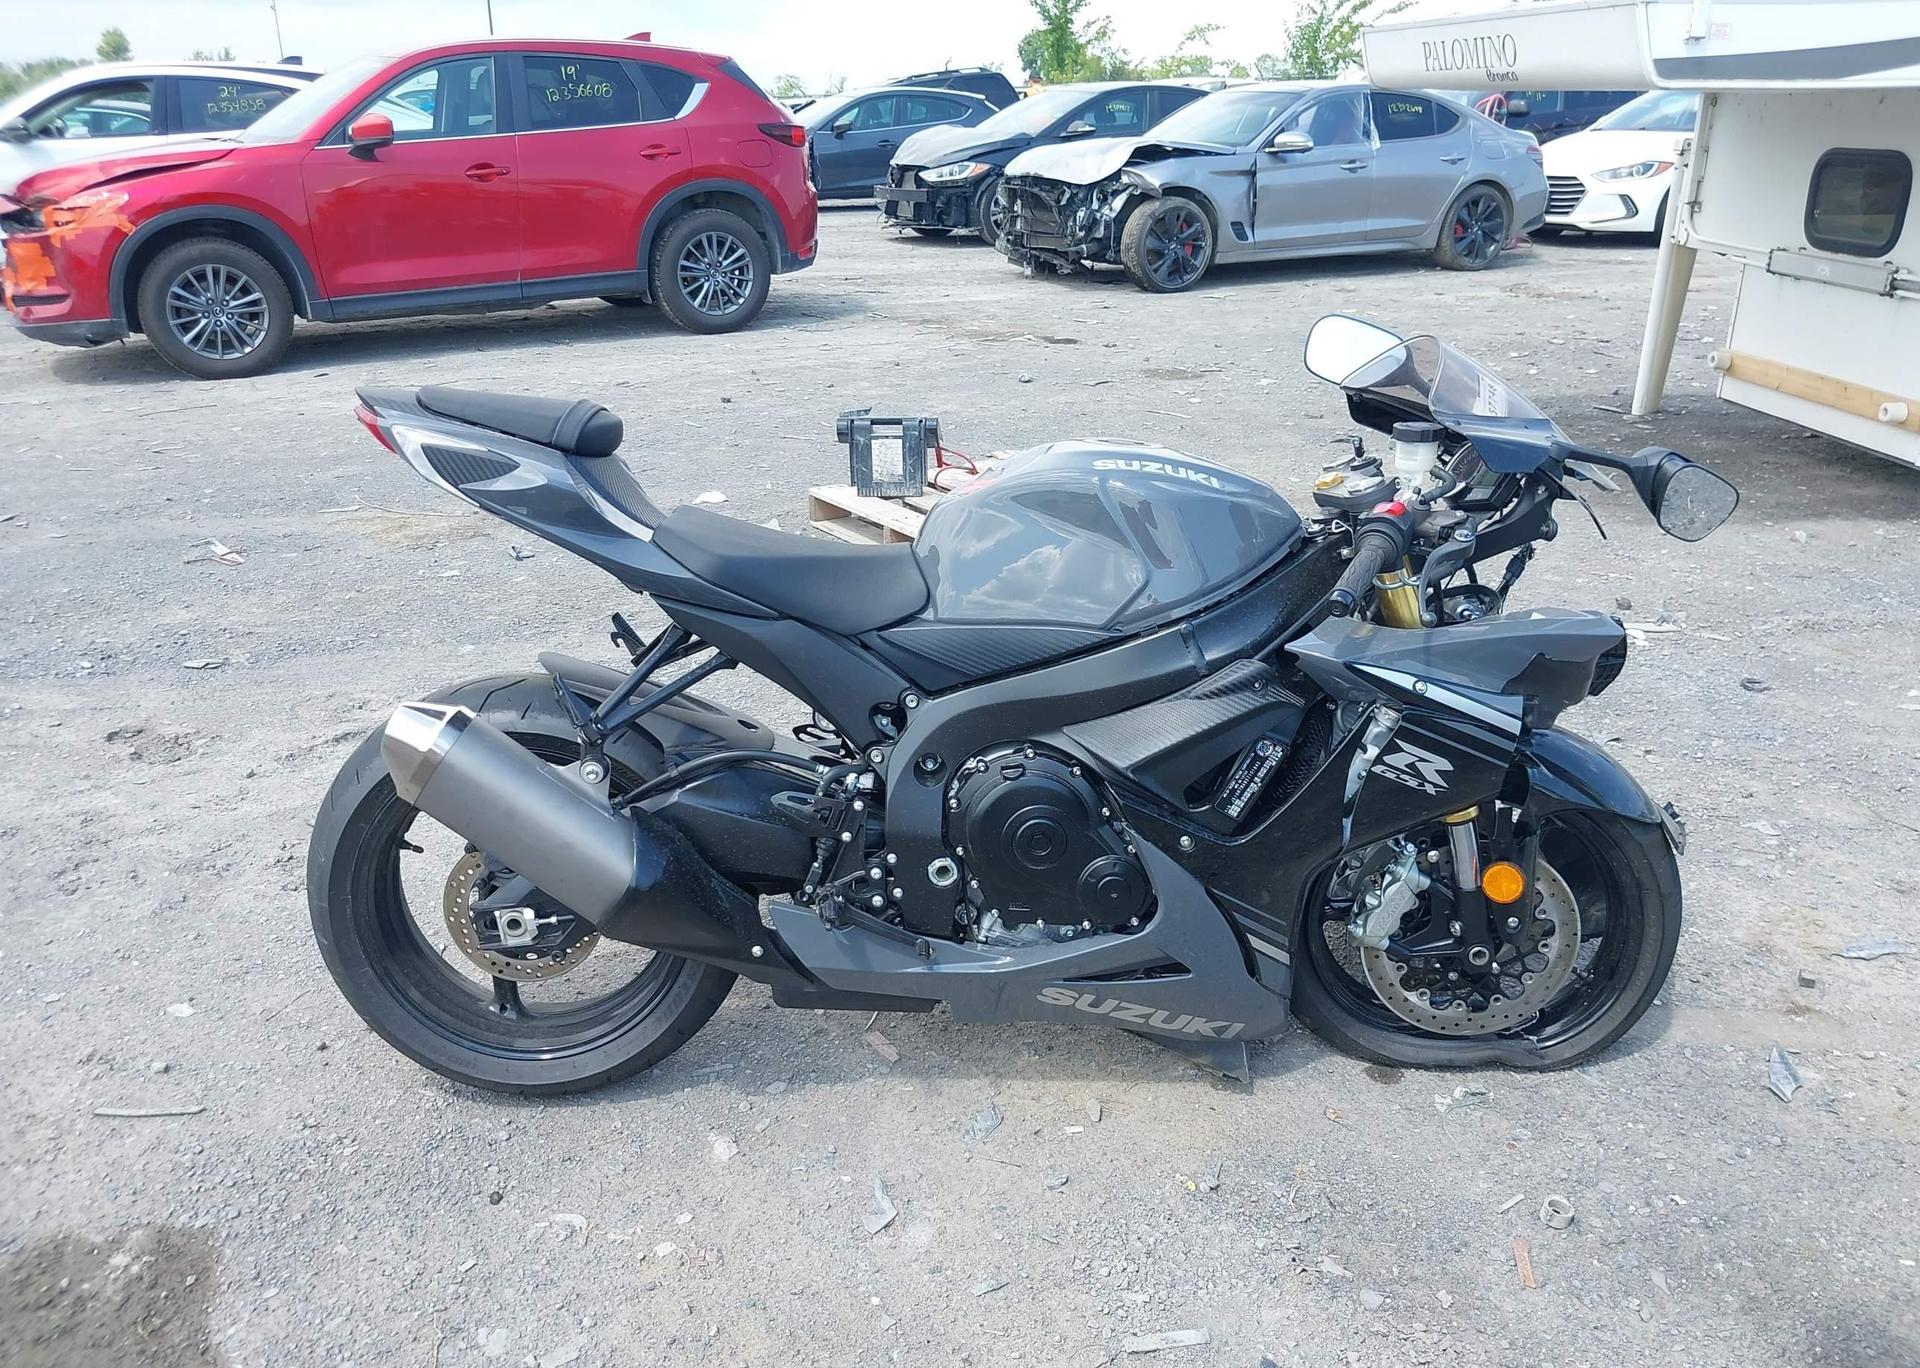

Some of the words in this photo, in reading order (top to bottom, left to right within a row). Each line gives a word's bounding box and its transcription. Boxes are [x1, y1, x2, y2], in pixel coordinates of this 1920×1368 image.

[1421, 33, 1517, 72] PALOMINO
[1486, 69, 1519, 81] Bronco
[1092, 459, 1220, 488] SUZUKI
[1036, 987, 1246, 1039] SUZUKI
